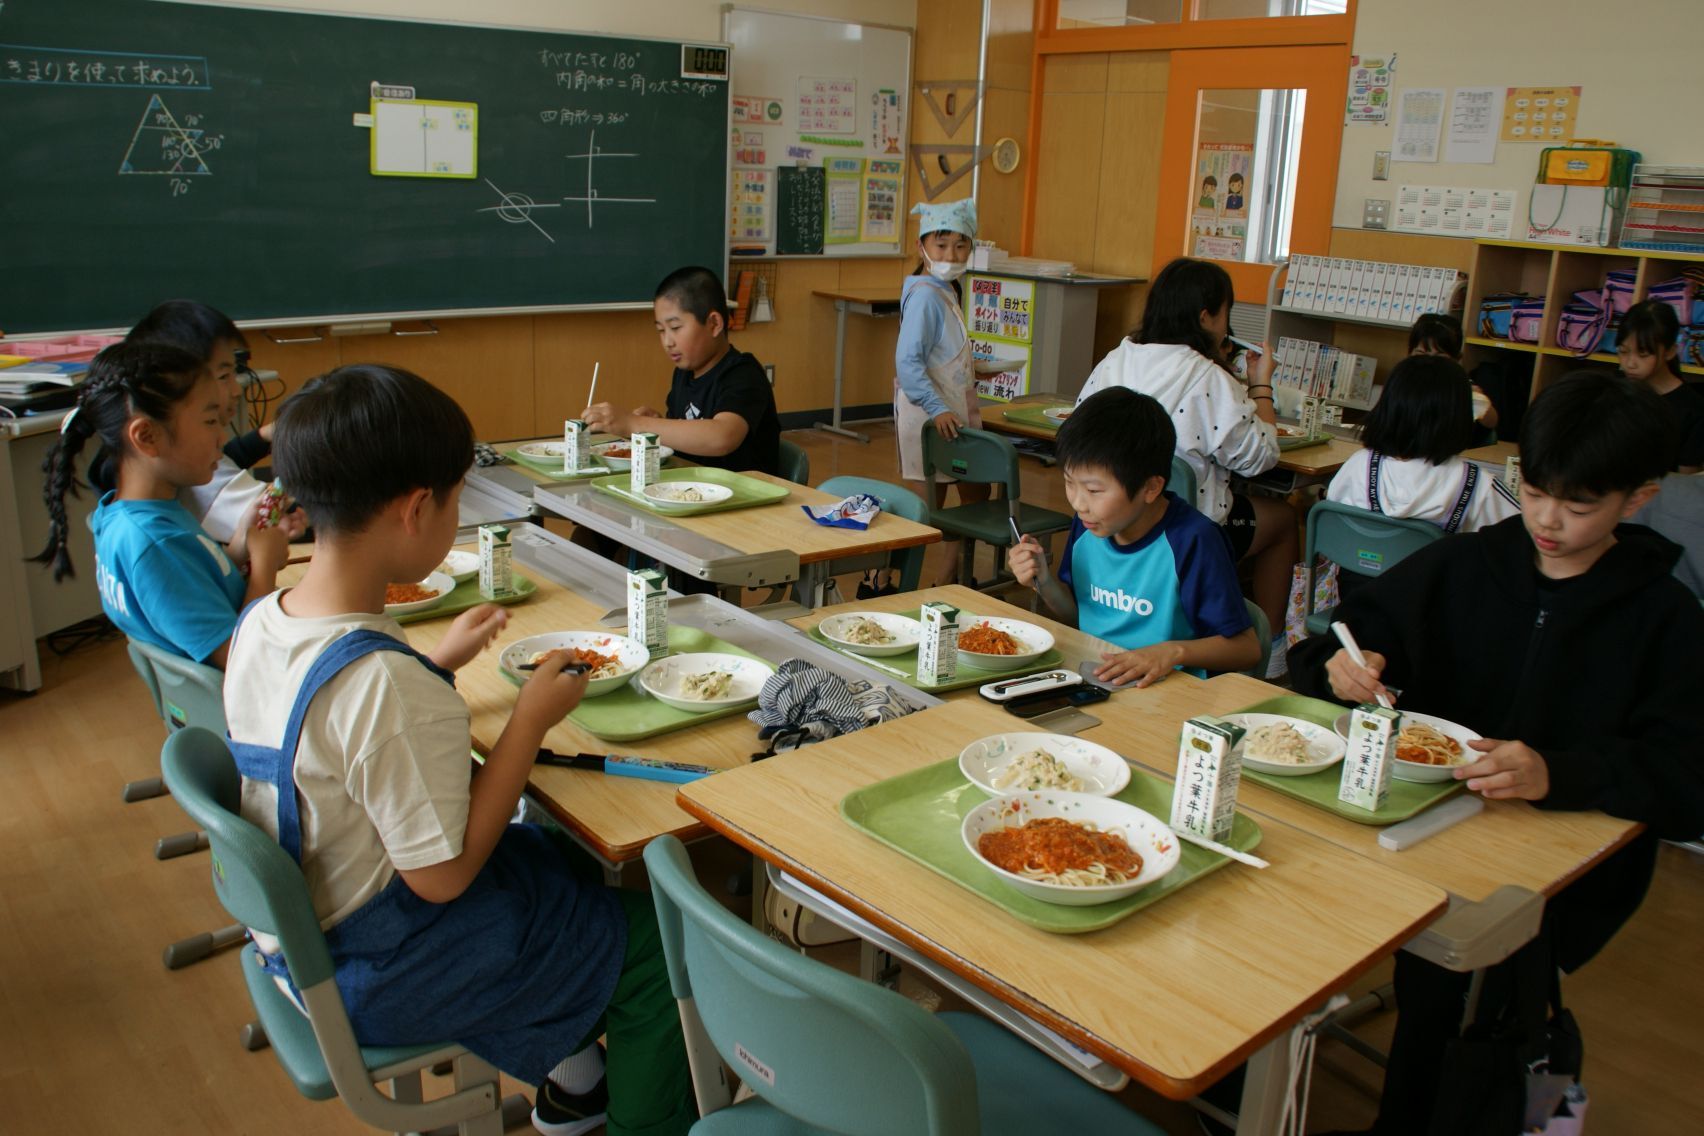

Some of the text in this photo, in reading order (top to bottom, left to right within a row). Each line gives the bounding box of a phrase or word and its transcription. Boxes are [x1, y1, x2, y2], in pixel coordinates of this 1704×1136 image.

[694, 47, 725, 72] 0:00
[170, 178, 192, 197] 70°
[1004, 297, 1028, 311] 自分で
[975, 307, 998, 321] ポイント
[1003, 311, 1028, 325] みんなで
[975, 320, 998, 333] 振り返り
[970, 340, 992, 354] To-do
[993, 384, 1015, 399] 流れ
[1354, 732, 1372, 789] よつ葉牛乳
[1184, 755, 1204, 830] よつ葉牛乳
